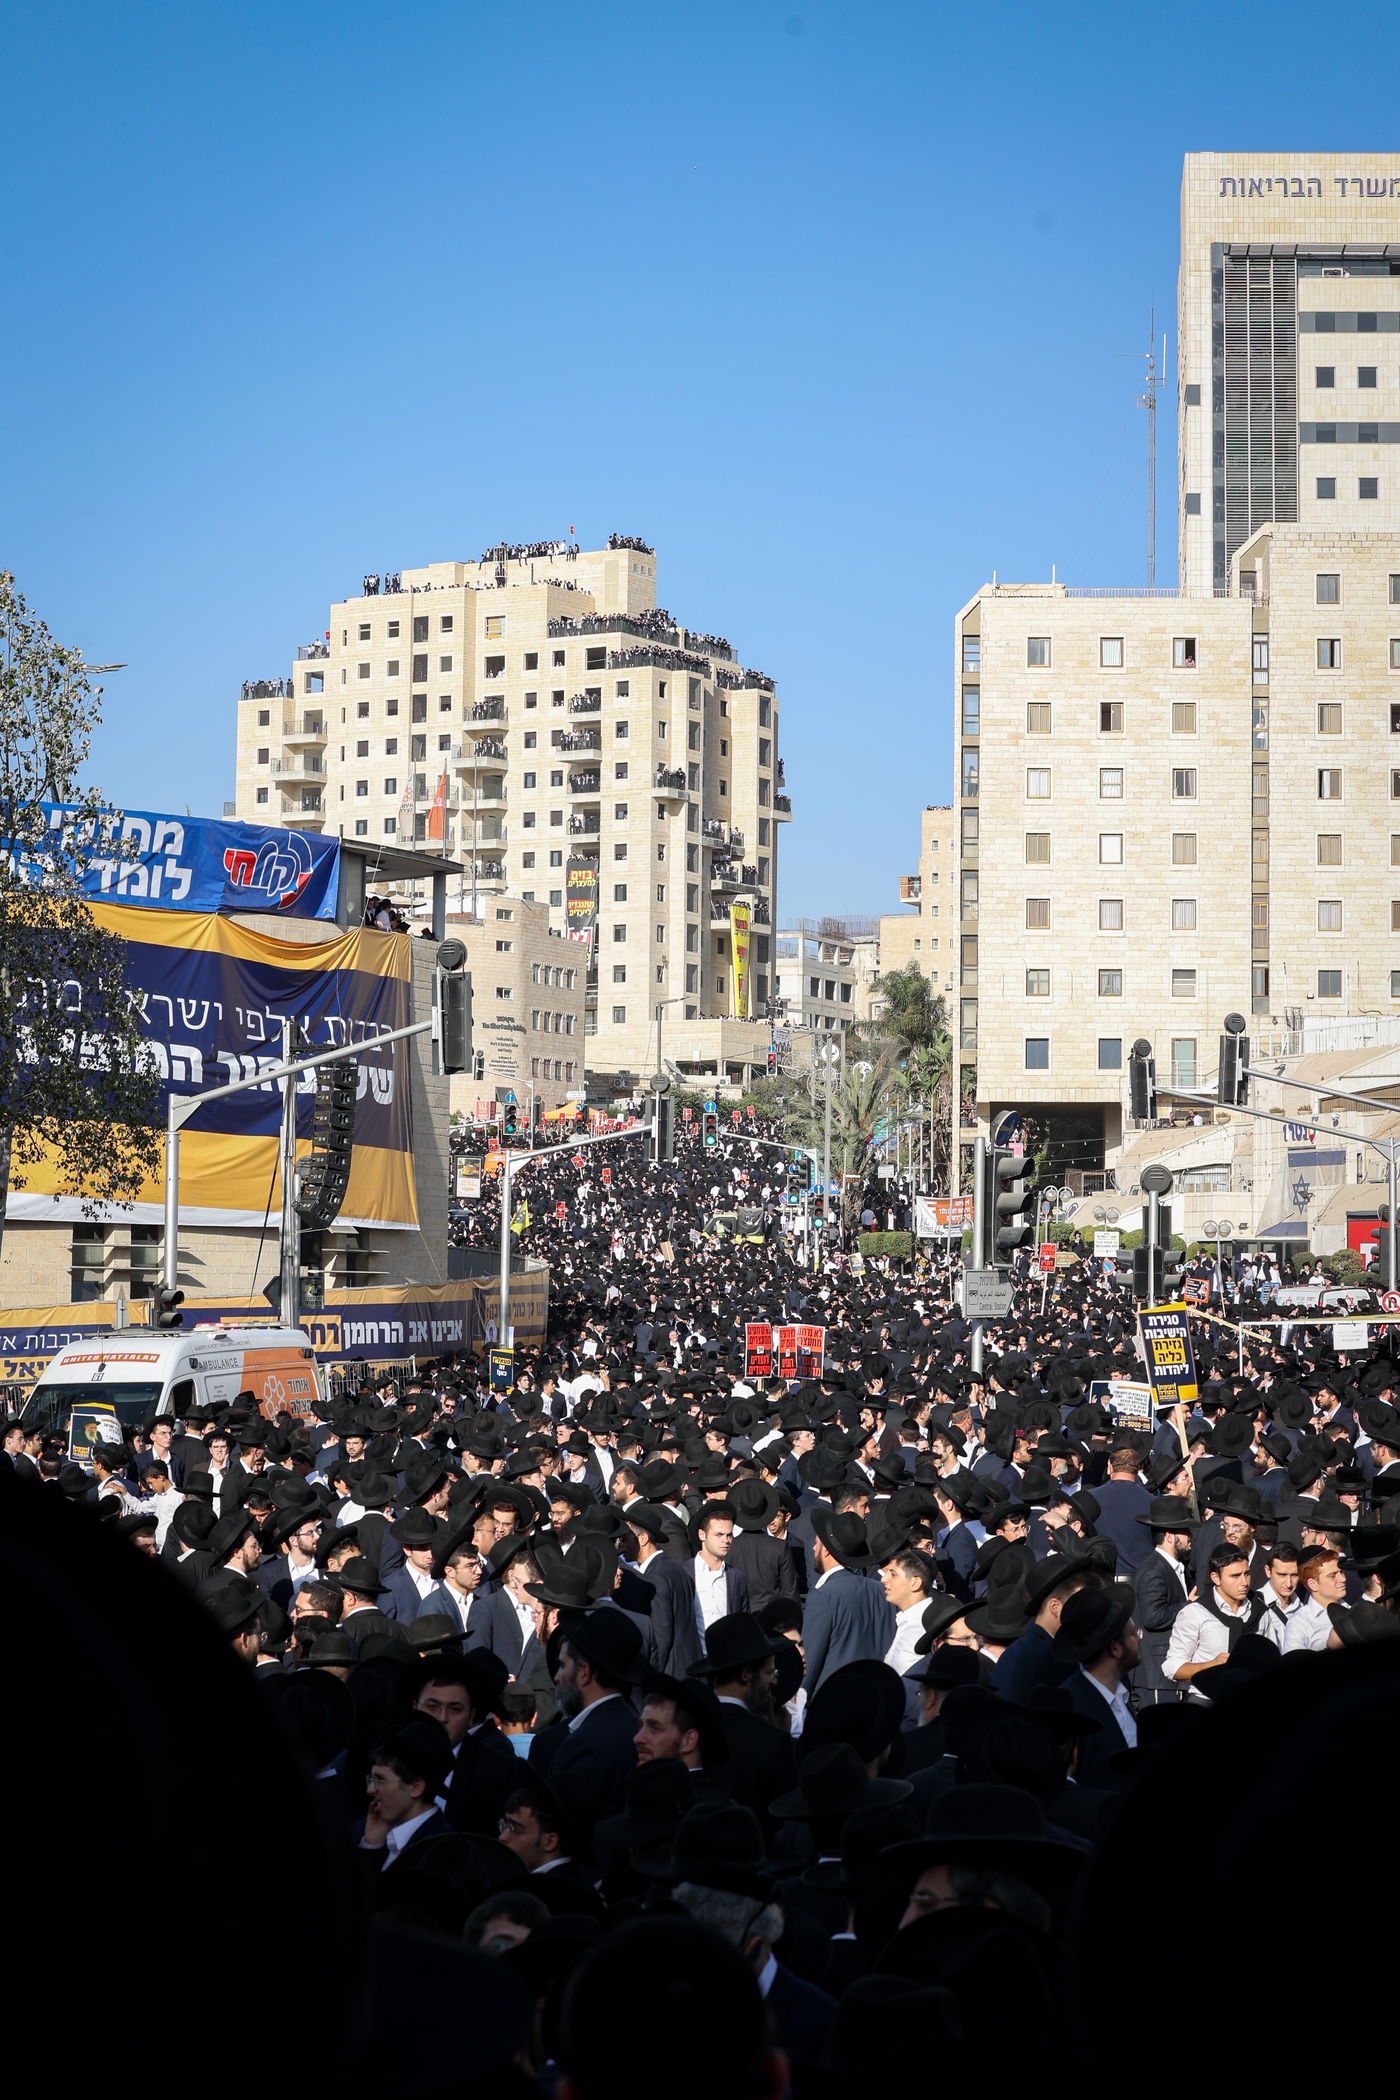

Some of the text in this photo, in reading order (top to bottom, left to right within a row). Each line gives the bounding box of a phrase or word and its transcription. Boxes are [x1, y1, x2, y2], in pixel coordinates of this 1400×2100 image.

[1219, 177, 1322, 198] הבריאות
[979, 1302, 1007, 1310] Central Station
[1148, 1314, 1180, 1327] סגירת
[343, 1321, 404, 1350] הרחמן
[409, 1321, 428, 1342] אב
[431, 1320, 463, 1342] אבינו
[1144, 1327, 1188, 1340] הישיבות
[1154, 1340, 1183, 1351] גזירת
[64, 1353, 158, 1364] UNITED HATZALAH
[1158, 1351, 1183, 1362] כליה
[199, 1357, 239, 1371] AMBULANCE
[1154, 1364, 1190, 1377] ליהדות
[287, 1378, 310, 1394] איחוד
